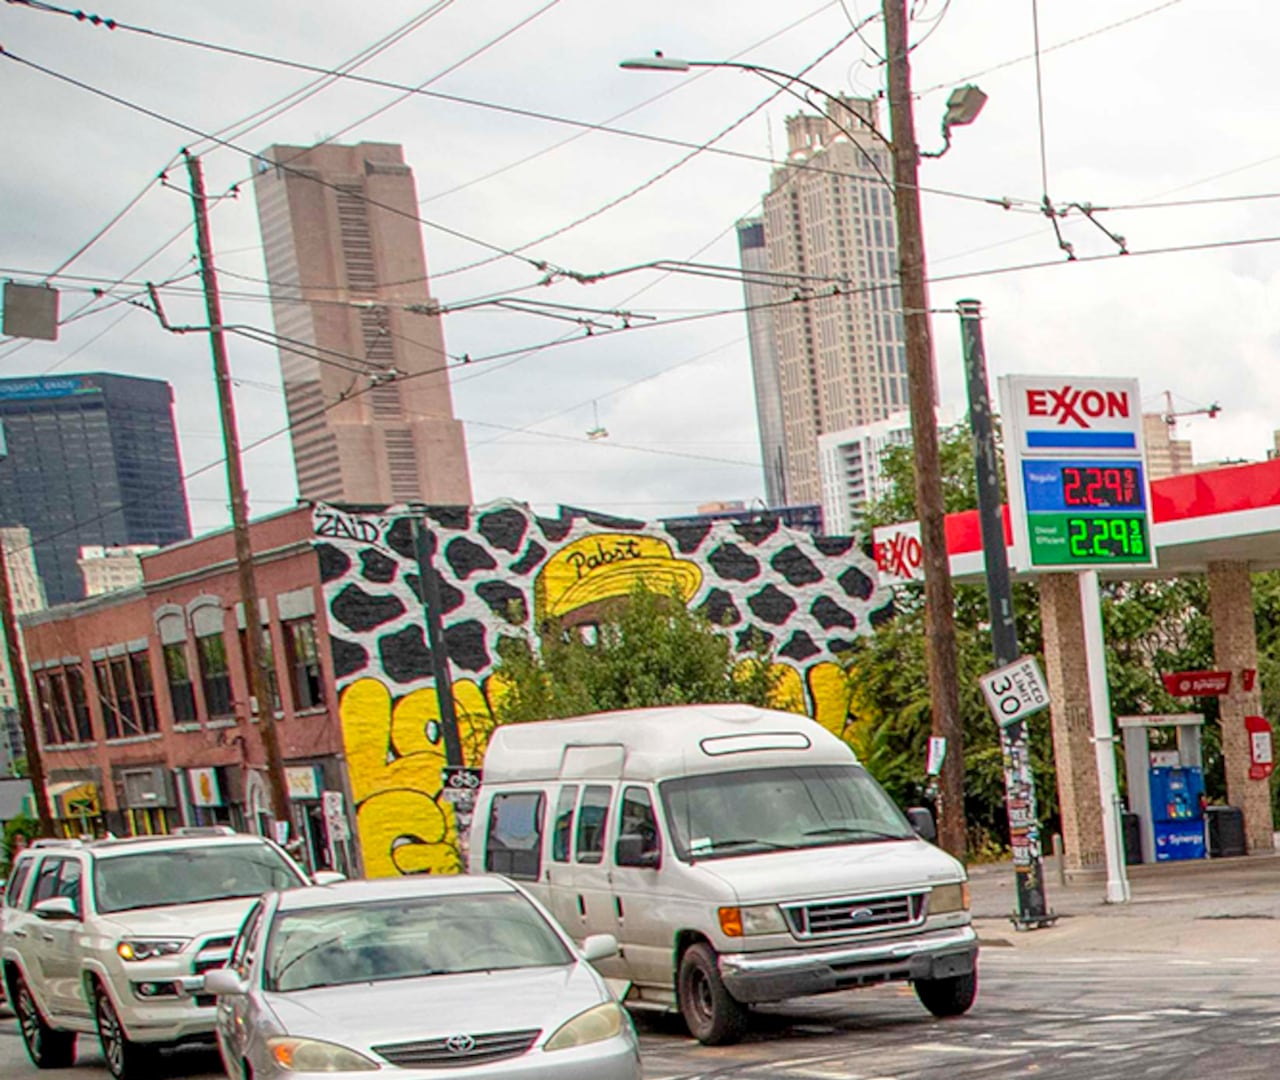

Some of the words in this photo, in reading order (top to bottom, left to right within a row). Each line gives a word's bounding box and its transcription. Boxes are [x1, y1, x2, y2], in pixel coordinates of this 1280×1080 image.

[1026, 386, 1130, 429] EXXON
[565, 540, 644, 579] Pabst
[874, 531, 923, 578] EXXO
[992, 676, 1021, 715] 30
[1012, 671, 1032, 703] LIMIT
[1021, 663, 1046, 703] SPEED
[1192, 681, 1226, 691] Synergy
